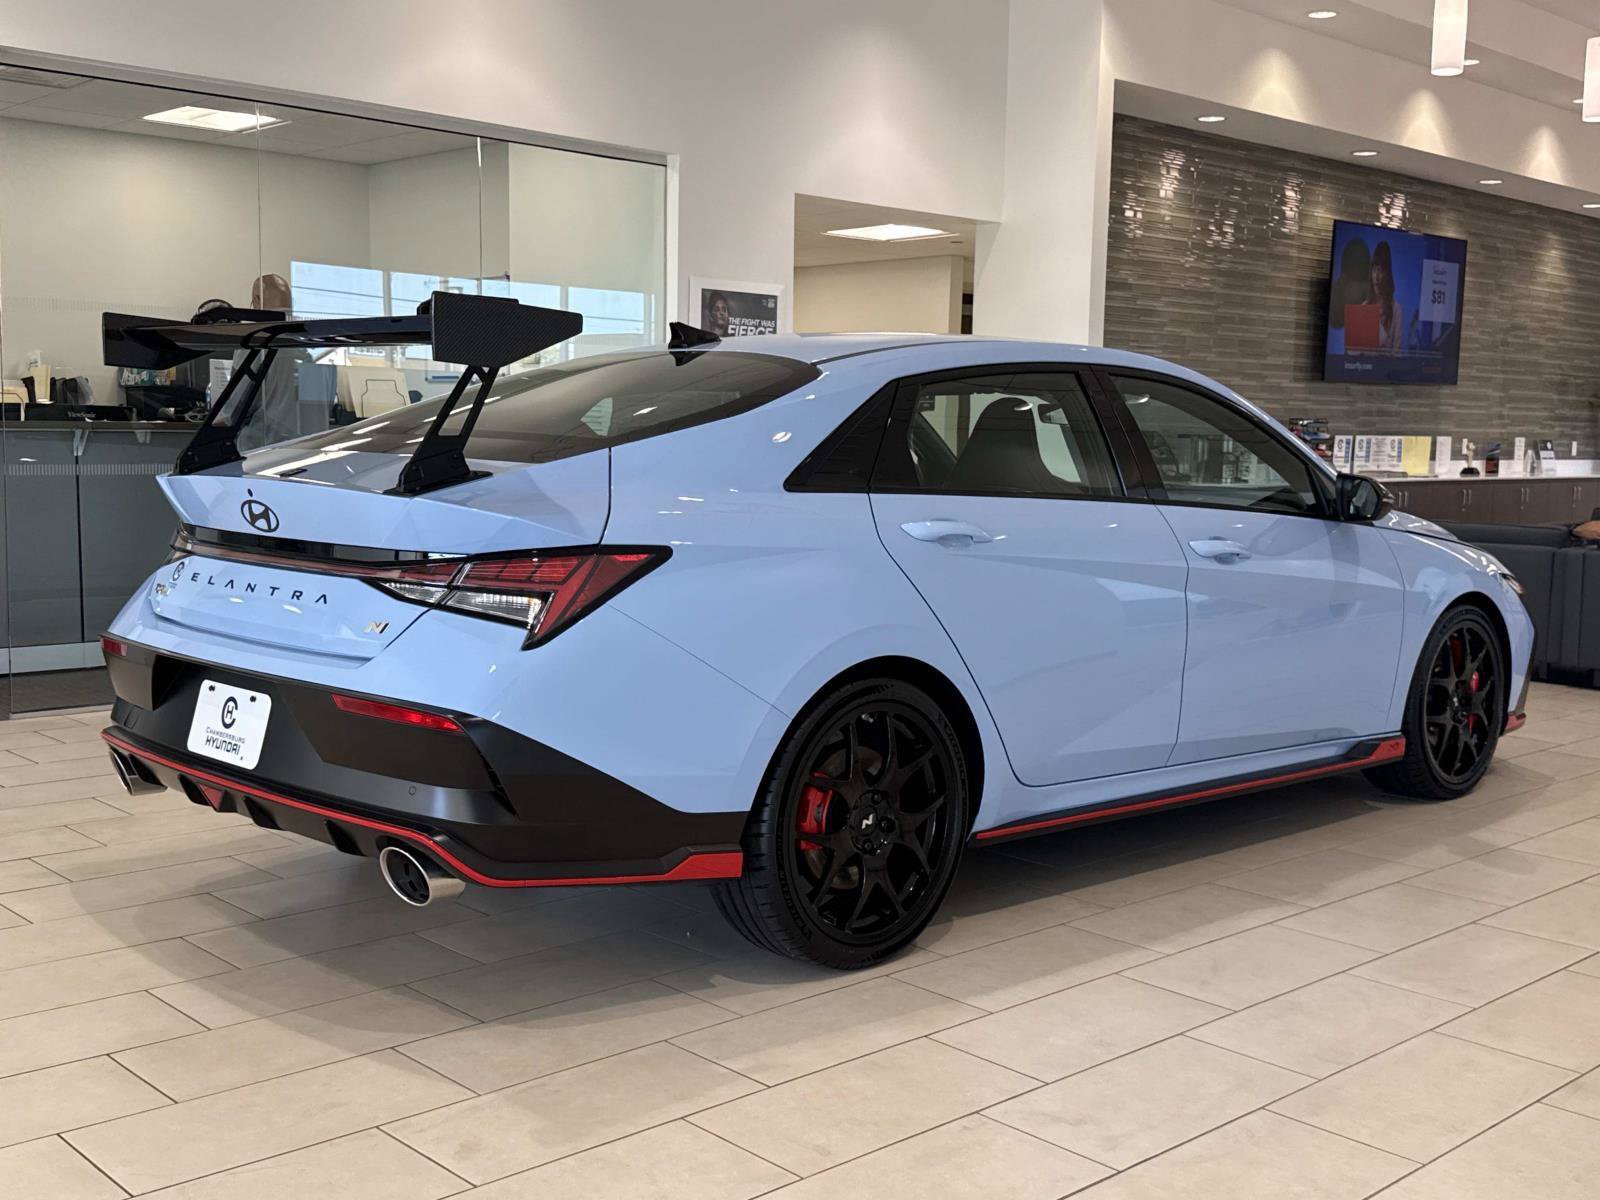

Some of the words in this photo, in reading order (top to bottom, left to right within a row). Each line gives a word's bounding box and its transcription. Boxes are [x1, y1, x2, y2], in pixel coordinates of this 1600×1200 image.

[728, 316, 741, 326] THE
[741, 318, 760, 327] FIGHT
[760, 319, 775, 328] WAS
[190, 572, 328, 605] ELANTRA
[204, 735, 241, 755] HYUNDAI
